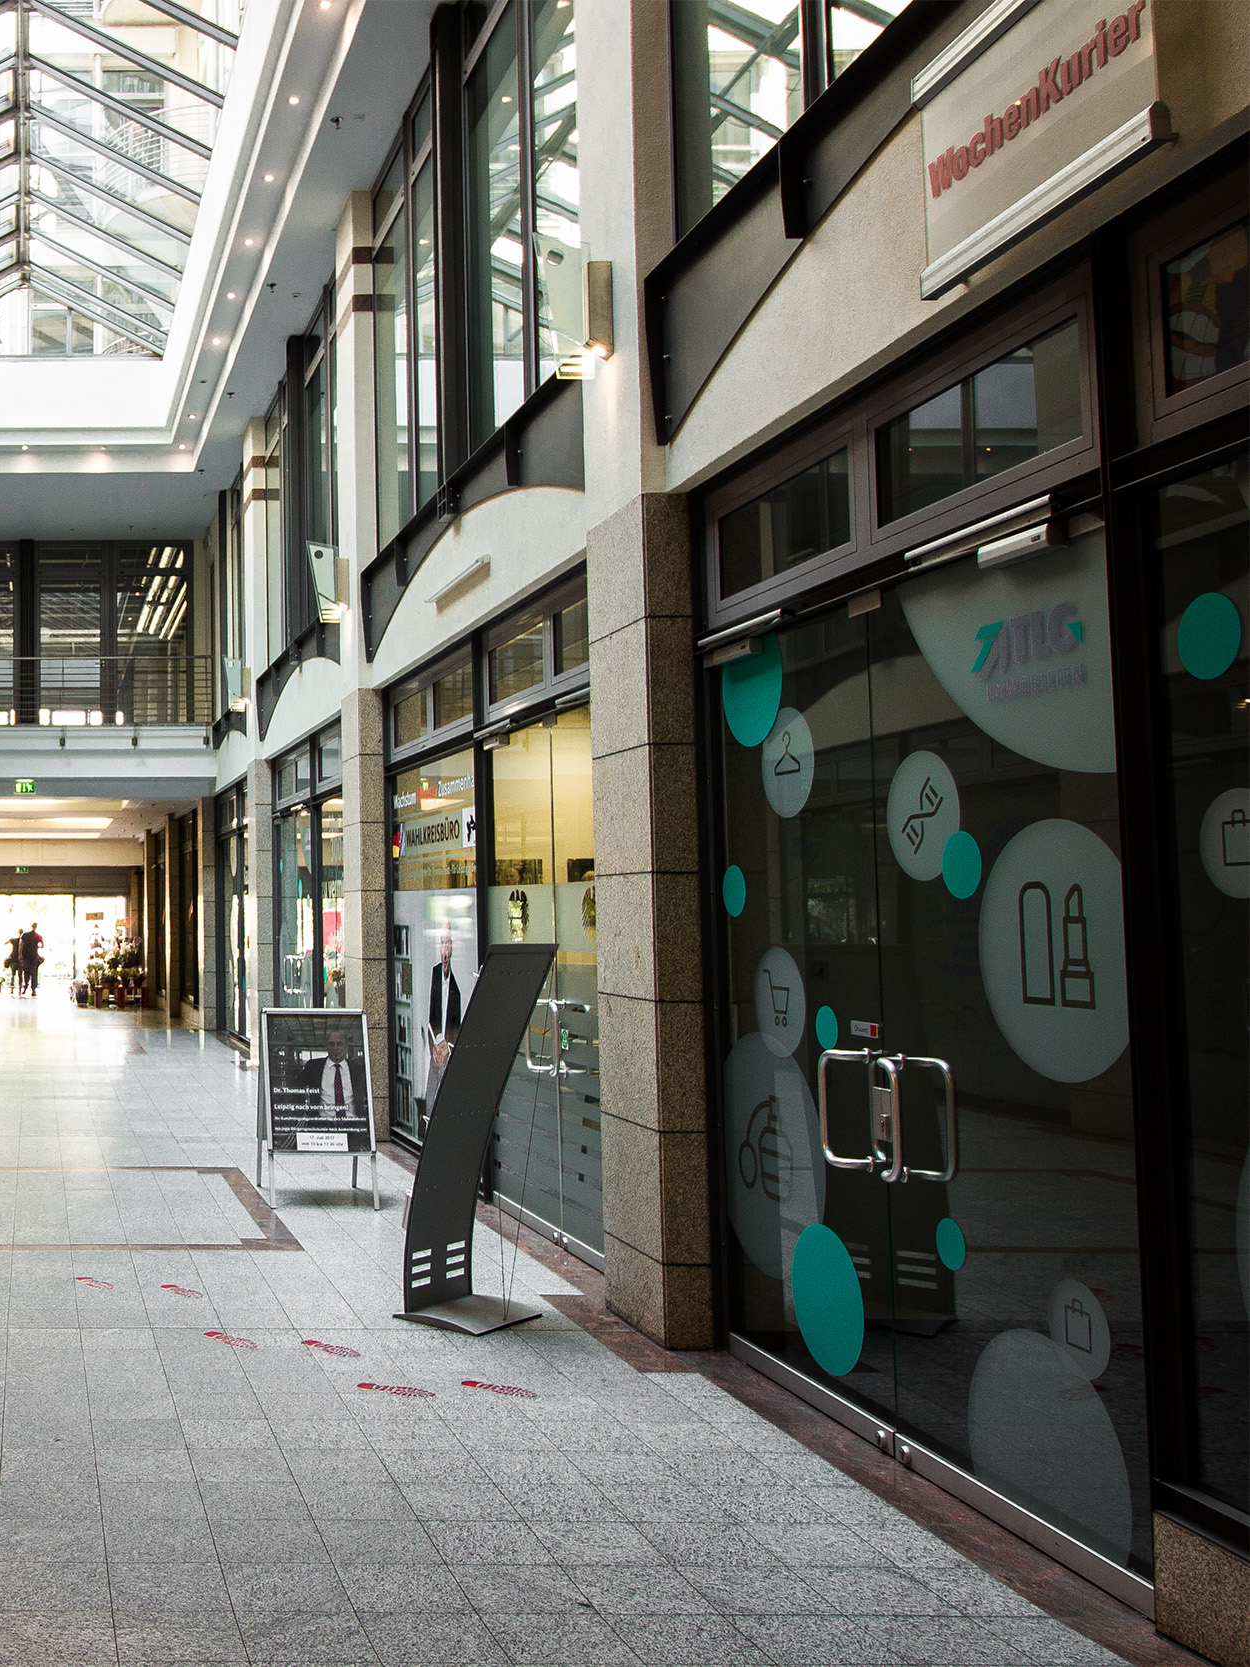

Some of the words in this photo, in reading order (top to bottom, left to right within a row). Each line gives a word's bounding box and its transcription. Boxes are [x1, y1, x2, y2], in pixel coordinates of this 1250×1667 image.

[928, 0, 1148, 199] WochenKurier
[986, 663, 1084, 701] IMMOBILIEN
[437, 771, 474, 797] Zusammenha
[406, 816, 460, 847] WAHLKREISBÜRO
